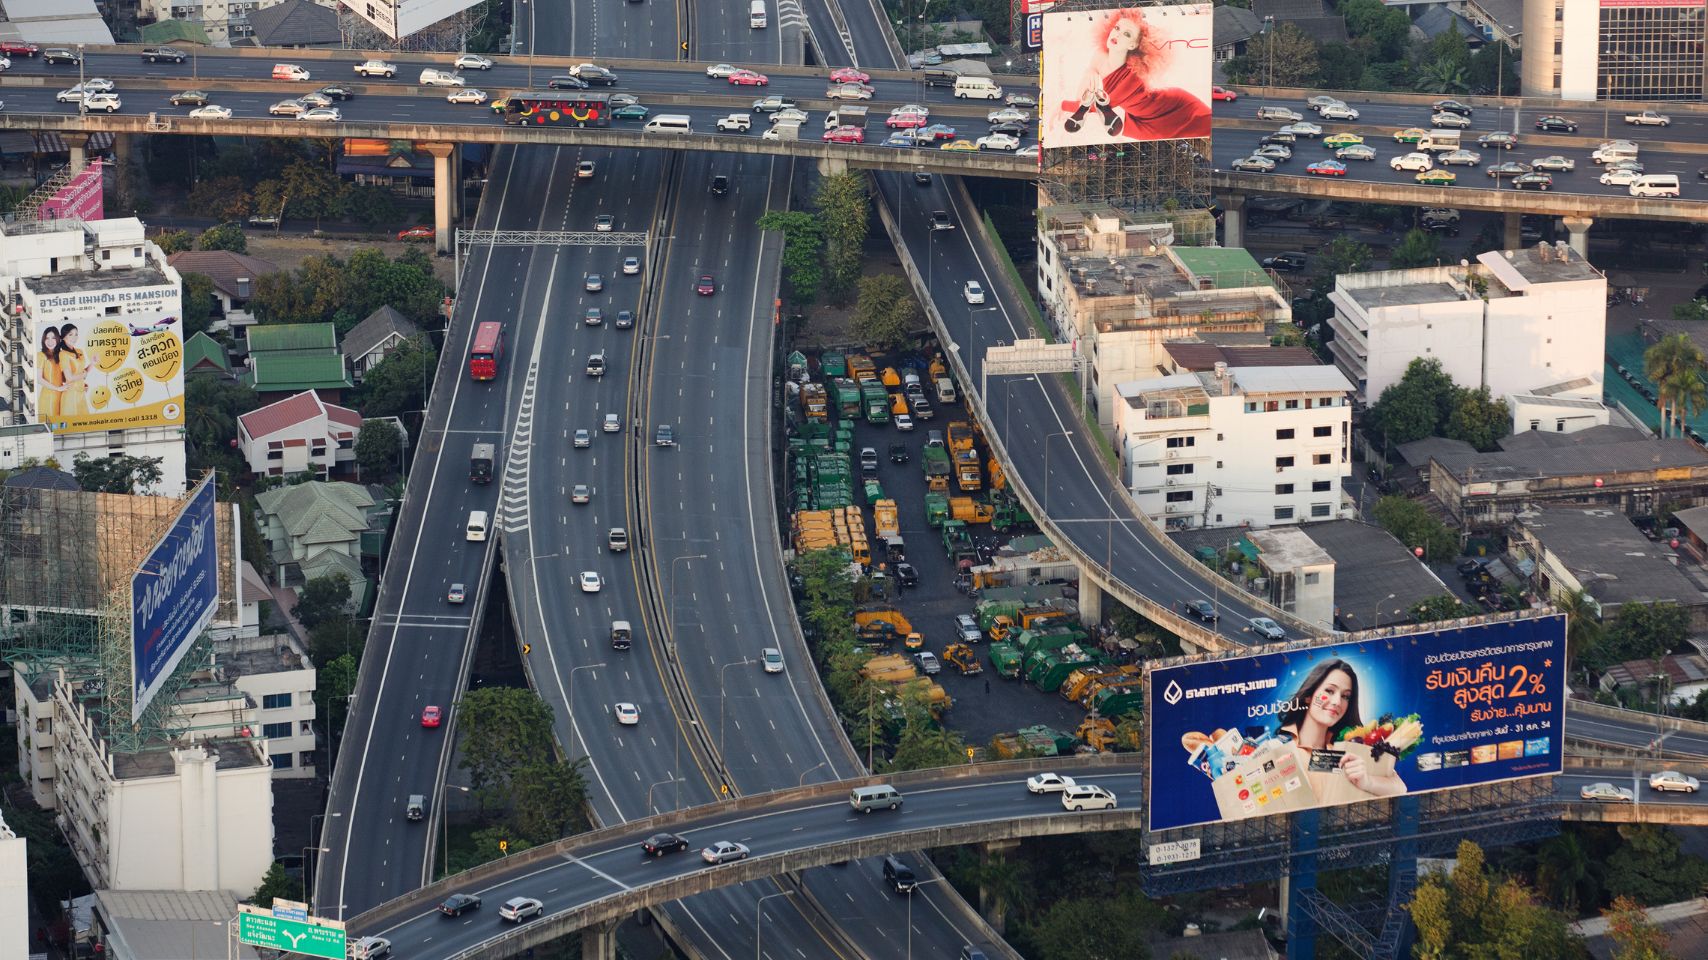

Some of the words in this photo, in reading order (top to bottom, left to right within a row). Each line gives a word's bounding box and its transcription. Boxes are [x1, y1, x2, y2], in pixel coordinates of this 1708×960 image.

[118, 293, 132, 301] RS
[134, 289, 178, 300] MANSION
[93, 325, 123, 335] ปลอดภัย
[87, 338, 129, 348] มาตรฐาน
[137, 337, 176, 360] สะดวก
[105, 349, 126, 357] สากล
[72, 417, 124, 427] www.nokair.com
[1426, 662, 1505, 690] รับเงินคืน
[1185, 678, 1277, 699] ธนาคารกรุงเทพ
[1454, 684, 1505, 709] สูงสุด
[1541, 721, 1550, 729] 54
